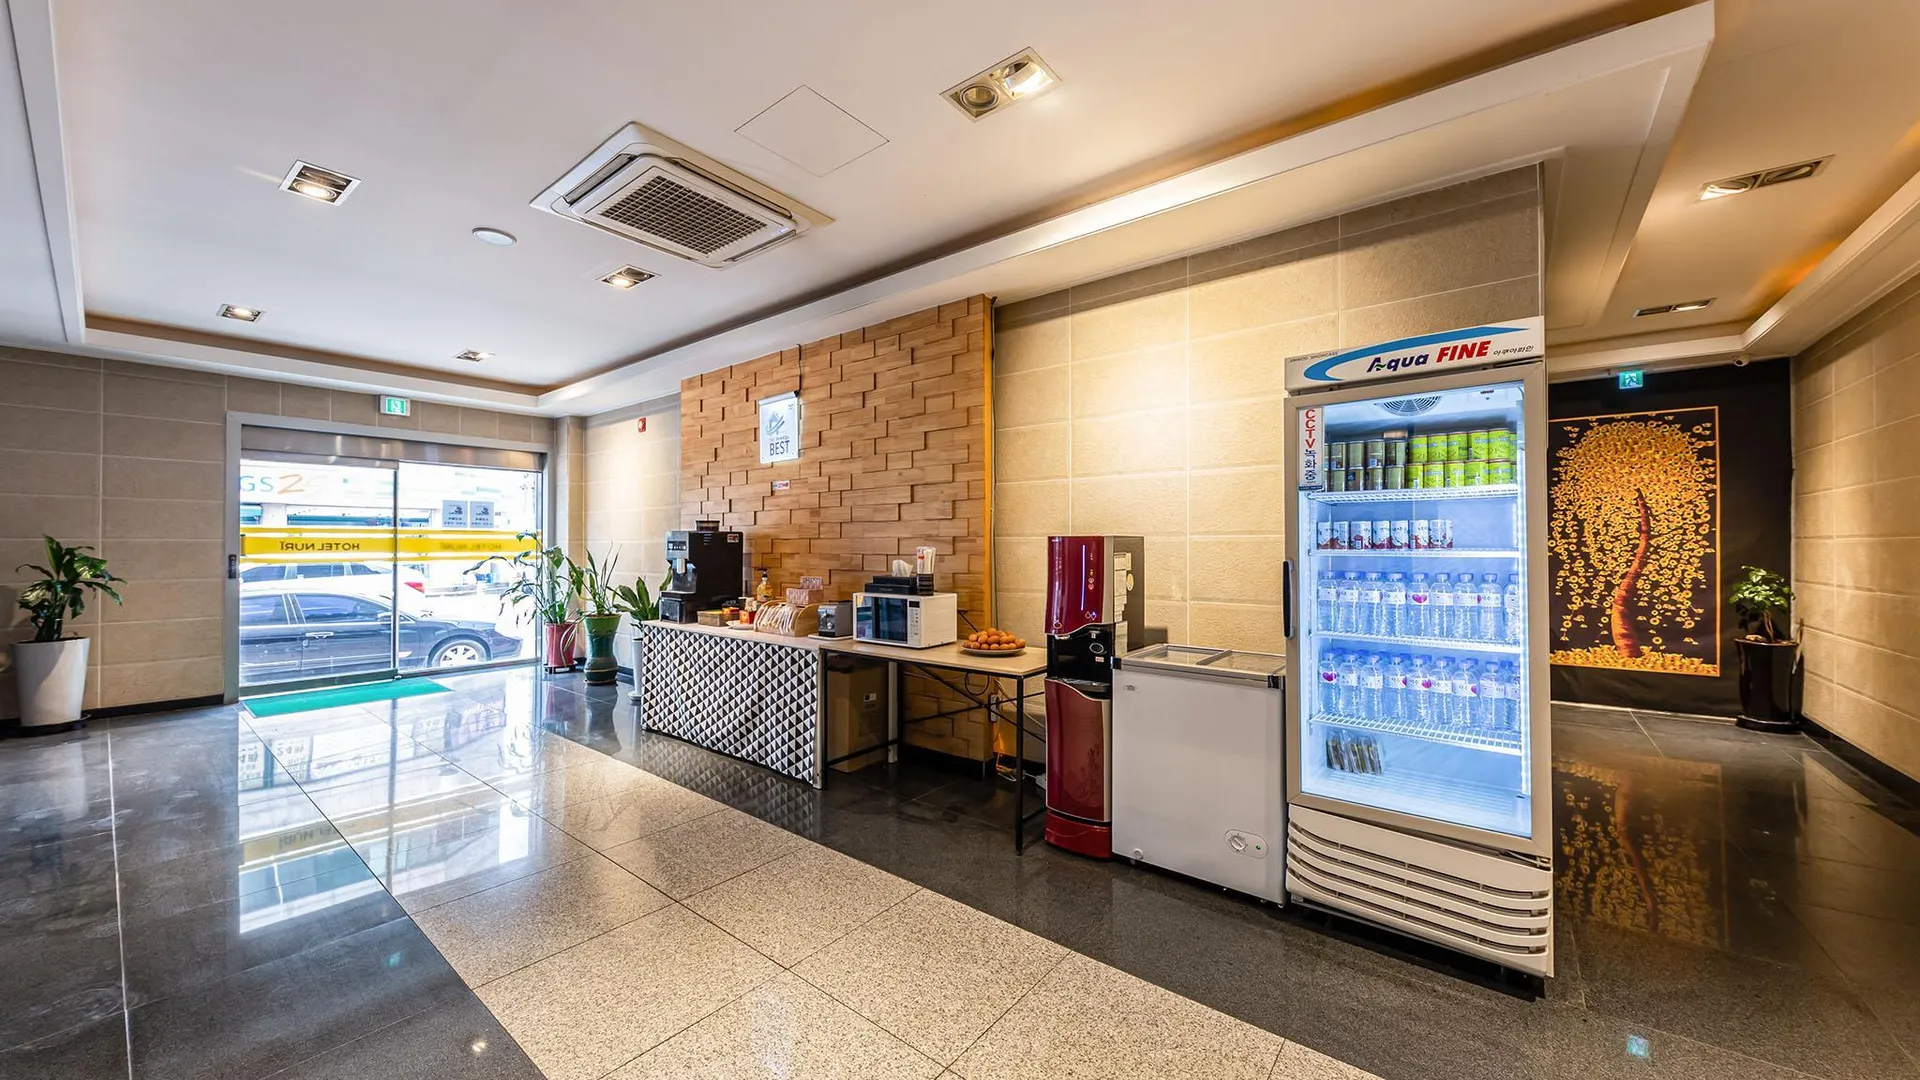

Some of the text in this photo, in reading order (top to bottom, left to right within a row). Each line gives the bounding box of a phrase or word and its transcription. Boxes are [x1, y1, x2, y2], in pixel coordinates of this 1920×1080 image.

[1366, 340, 1491, 373] Aqua FINE
[1305, 409, 1316, 449] CCTV
[769, 440, 790, 456] BEST
[1305, 449, 1317, 480] 녹화중
